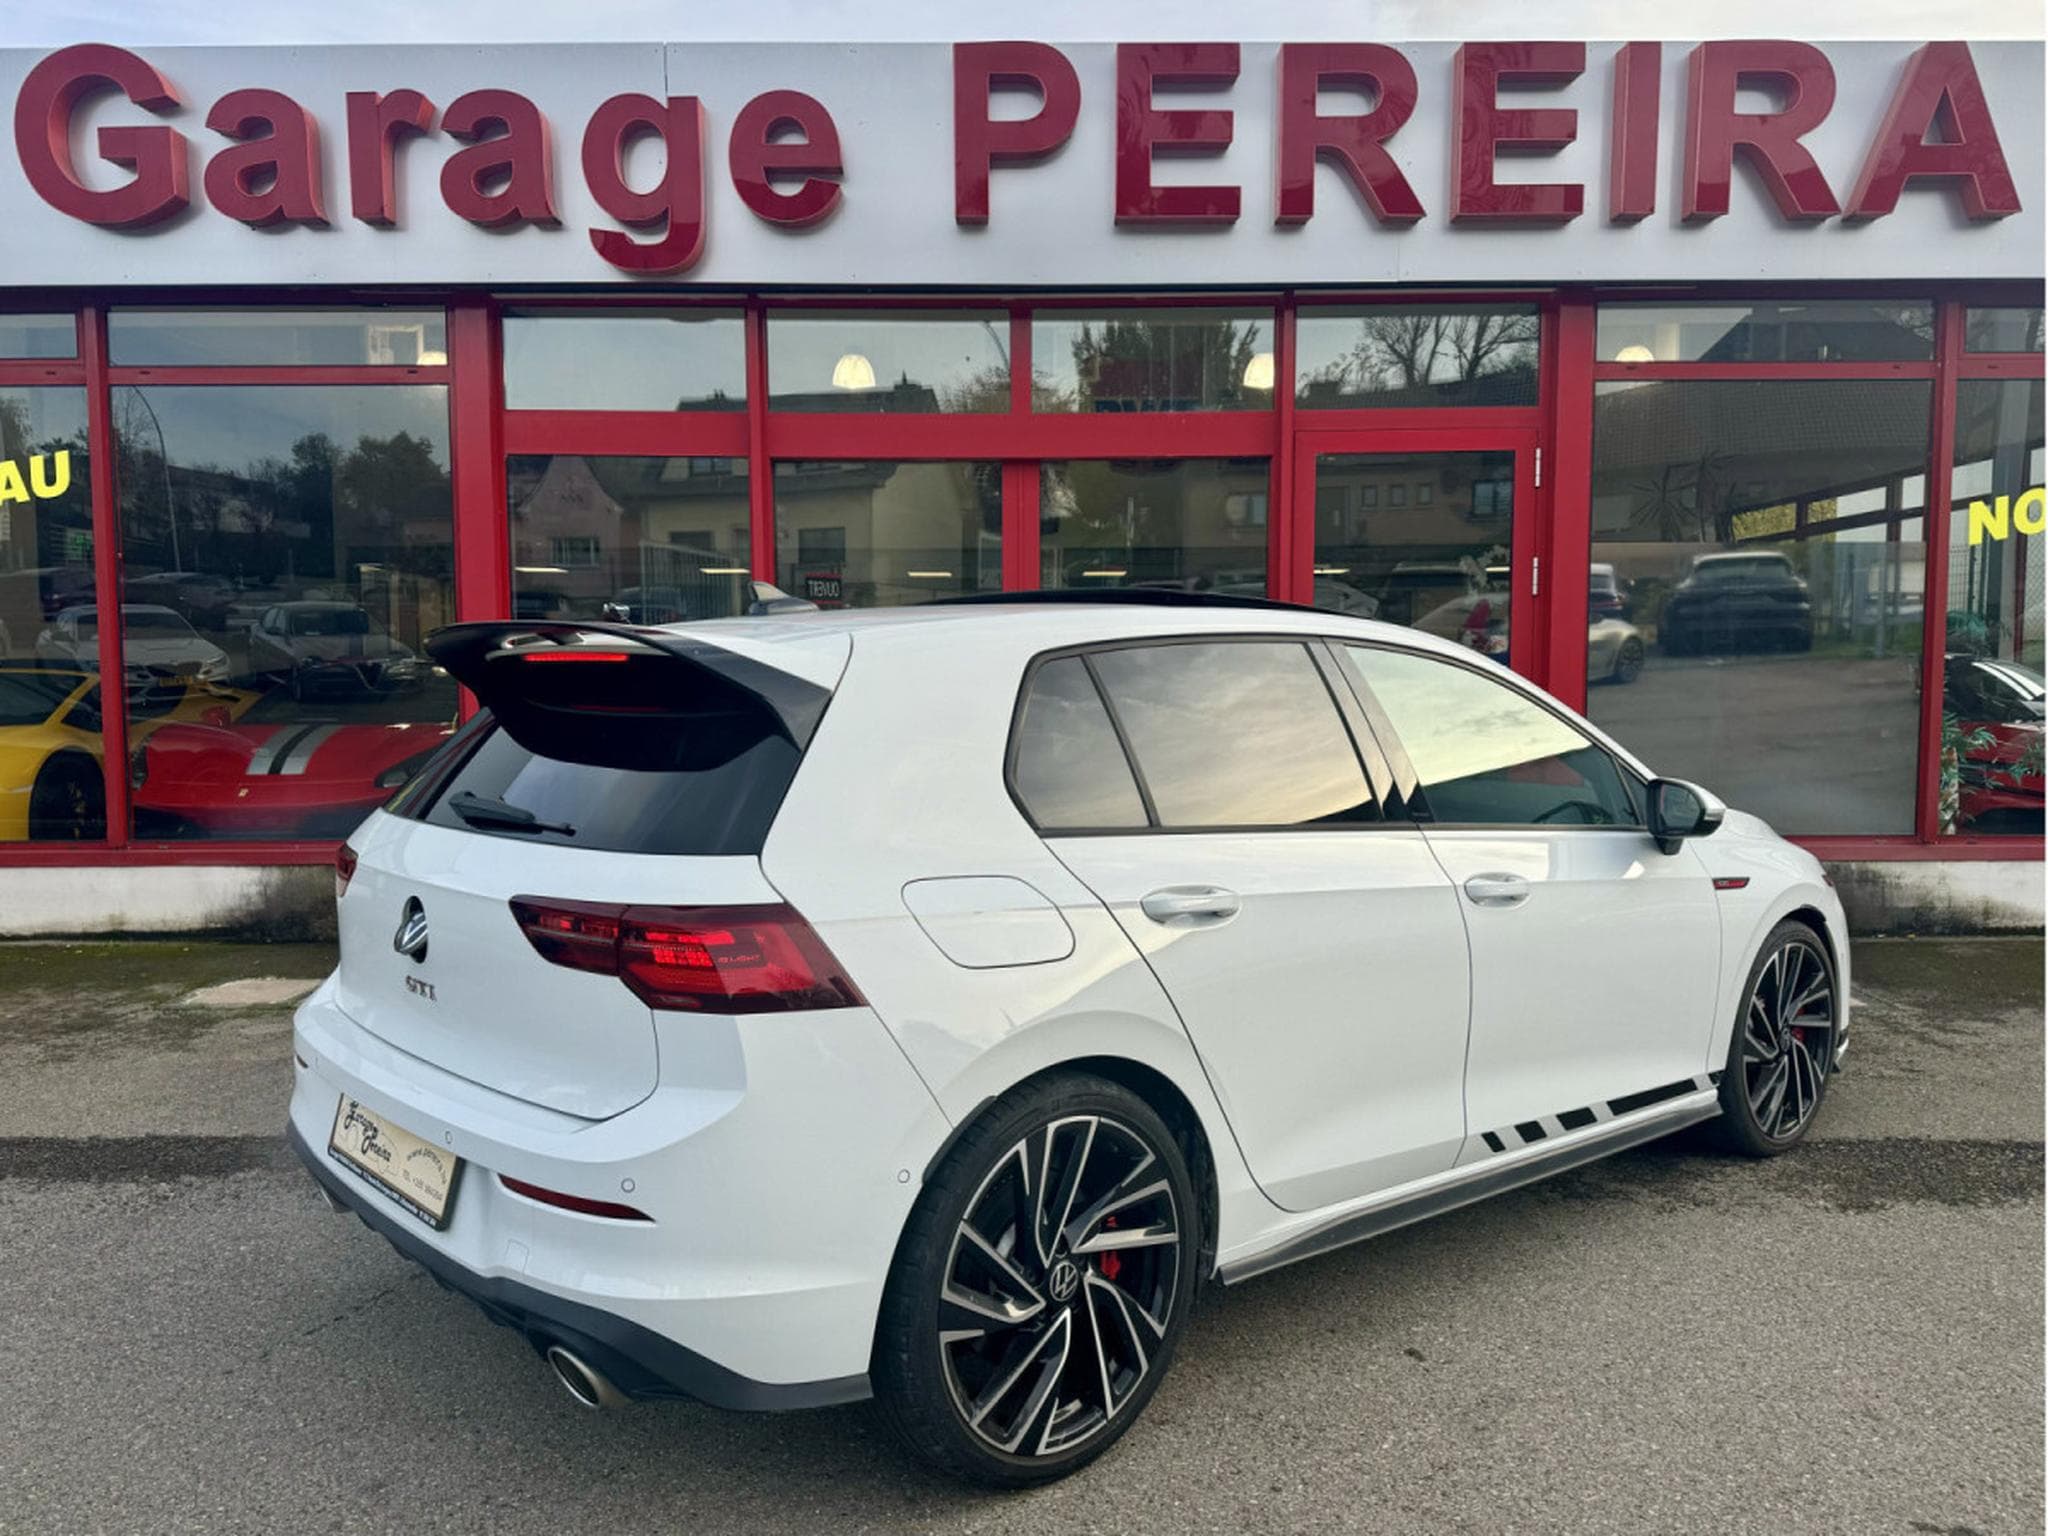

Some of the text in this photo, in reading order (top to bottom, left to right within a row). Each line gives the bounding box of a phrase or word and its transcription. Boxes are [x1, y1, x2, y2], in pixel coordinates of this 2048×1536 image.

[14, 39, 2022, 275] Garage PEREIRA
[0, 450, 70, 507] AU
[1968, 487, 2046, 546] NO
[406, 975, 437, 1001] GTI
